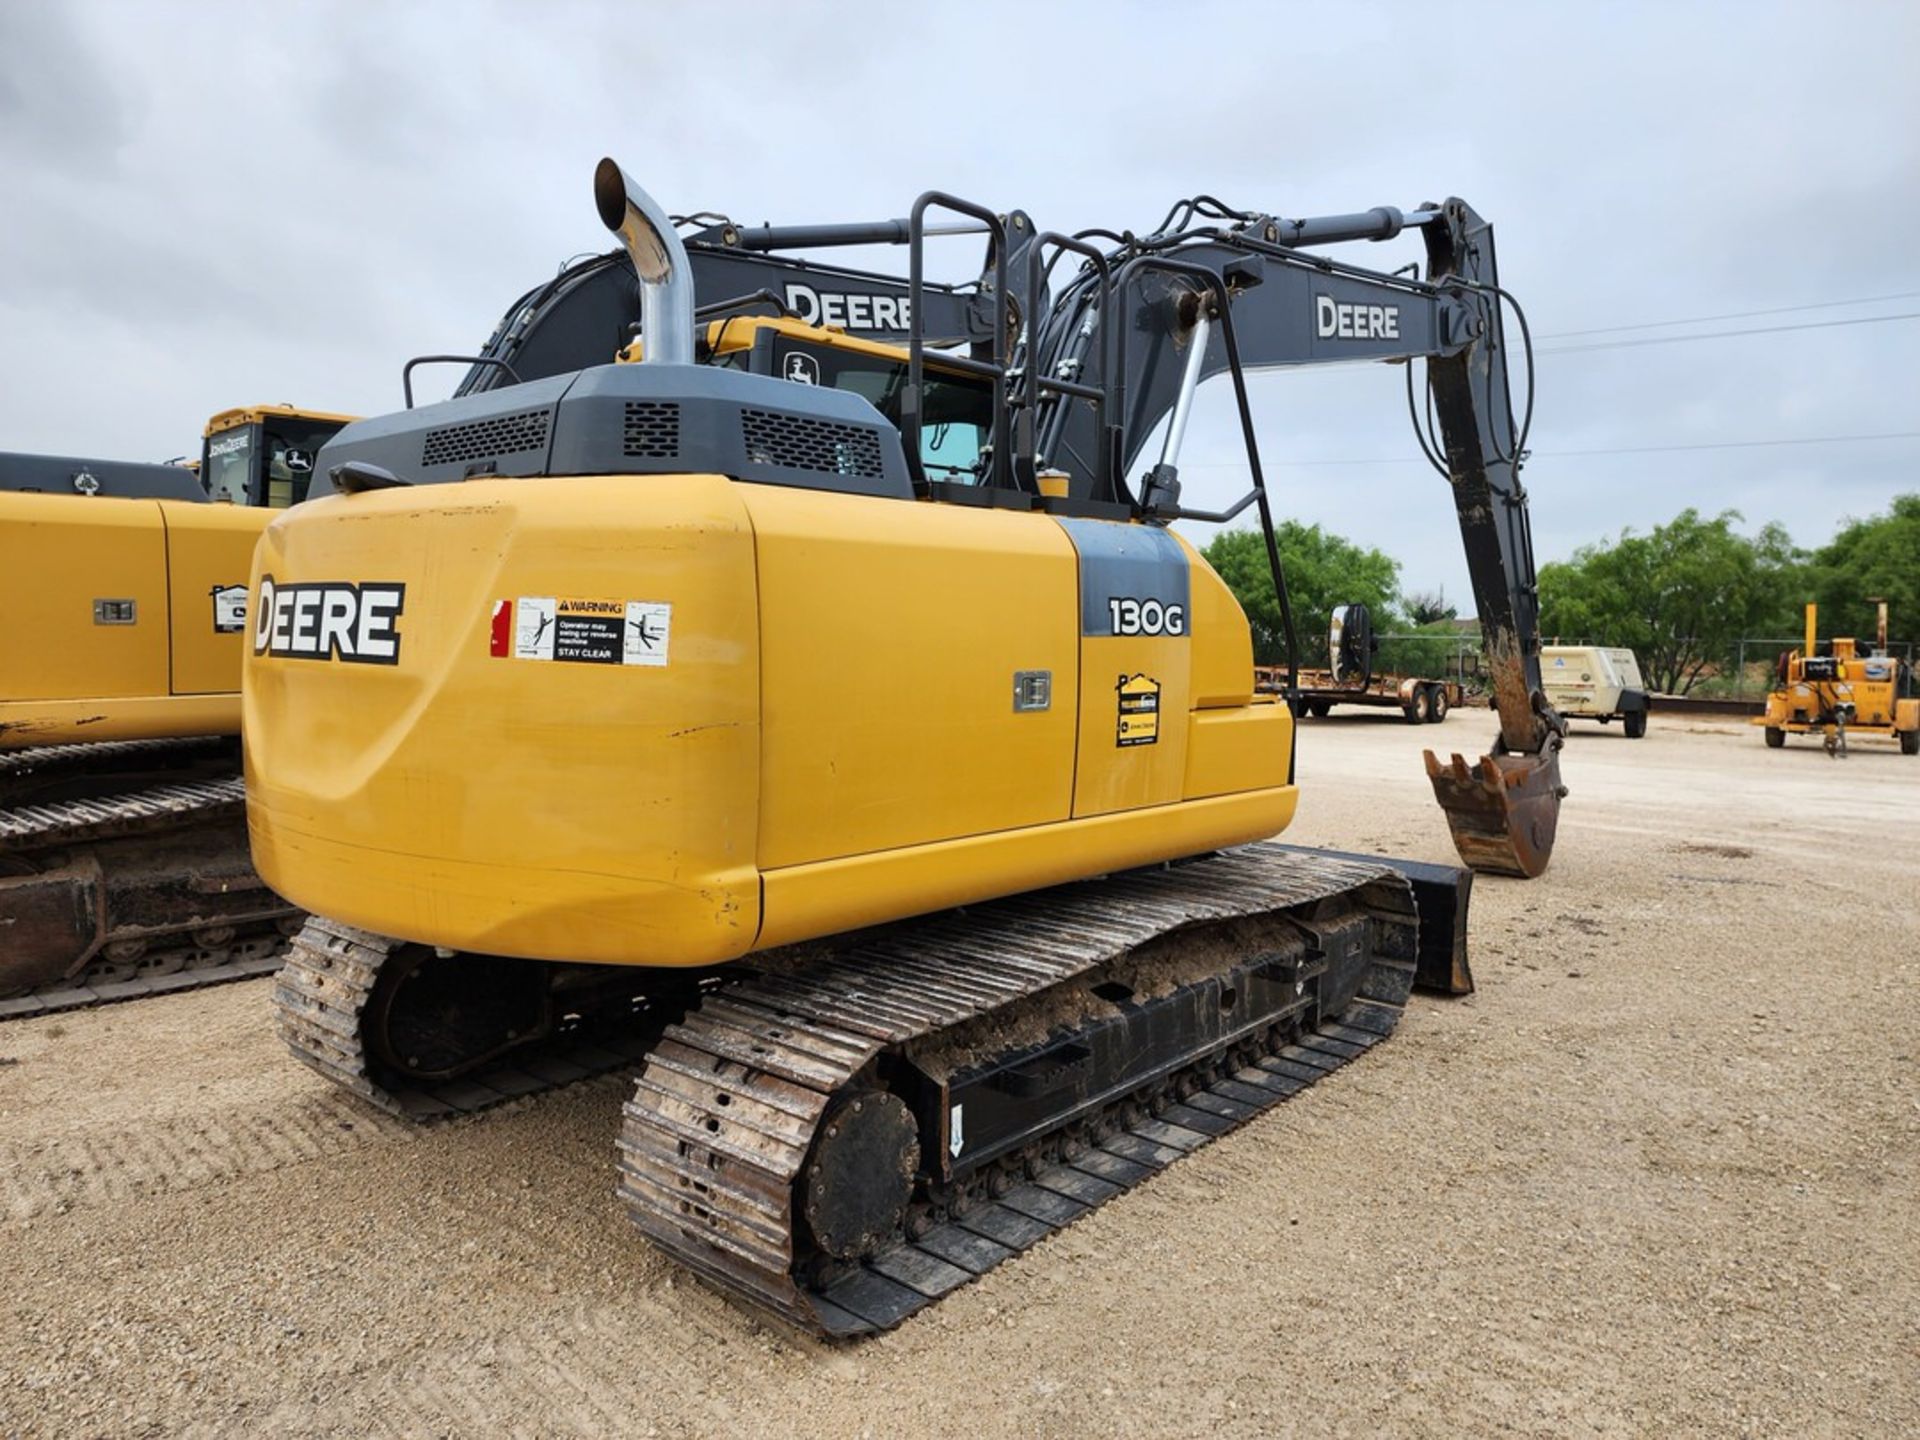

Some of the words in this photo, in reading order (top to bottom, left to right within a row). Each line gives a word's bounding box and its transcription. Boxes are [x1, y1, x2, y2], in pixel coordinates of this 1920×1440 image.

[1317, 296, 1399, 338] DEERE
[570, 601, 622, 614] WARNING
[255, 579, 401, 658] DEERE
[1110, 599, 1183, 634] 130G
[560, 621, 590, 630] Operator
[591, 624, 607, 632] may
[559, 631, 580, 639] swing
[558, 648, 580, 657] STAY
[581, 649, 612, 659] CLEAR
